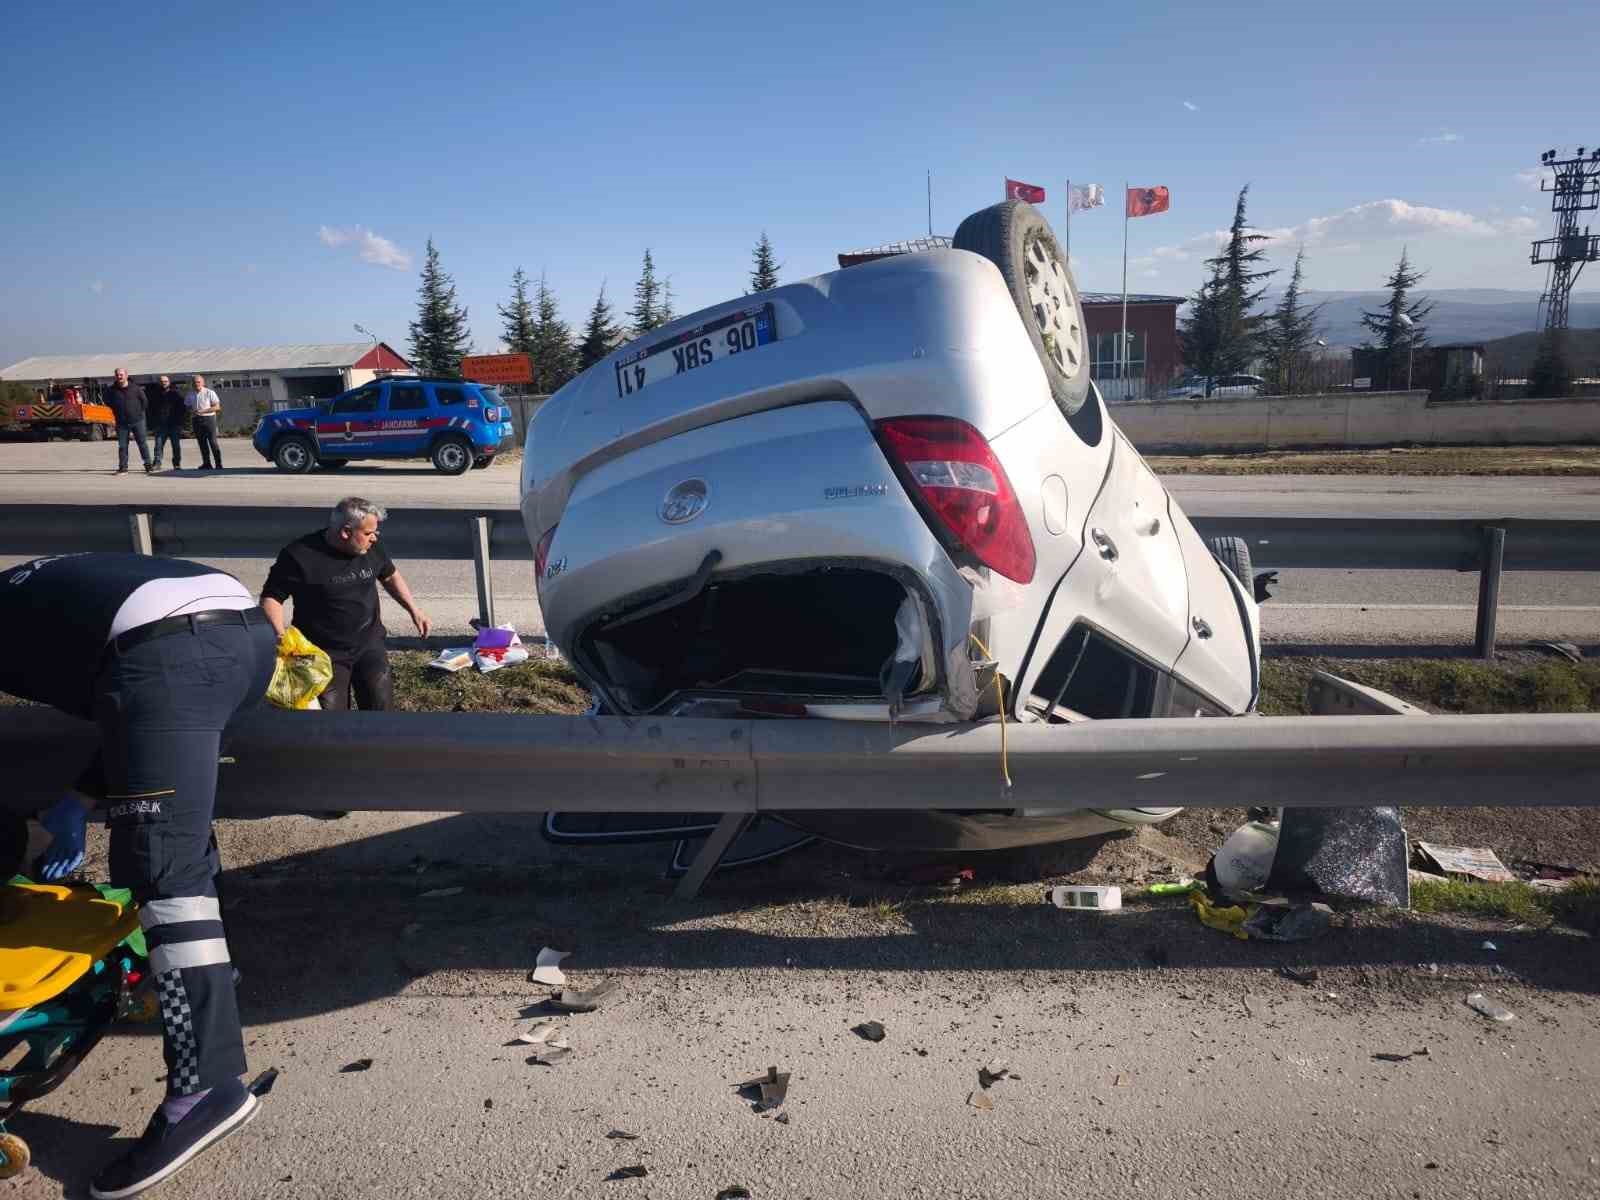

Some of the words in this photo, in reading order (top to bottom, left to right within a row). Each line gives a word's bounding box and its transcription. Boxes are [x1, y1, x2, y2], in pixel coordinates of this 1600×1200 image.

[726, 322, 756, 355] 06
[672, 337, 713, 375] SBK
[623, 365, 646, 395] 41
